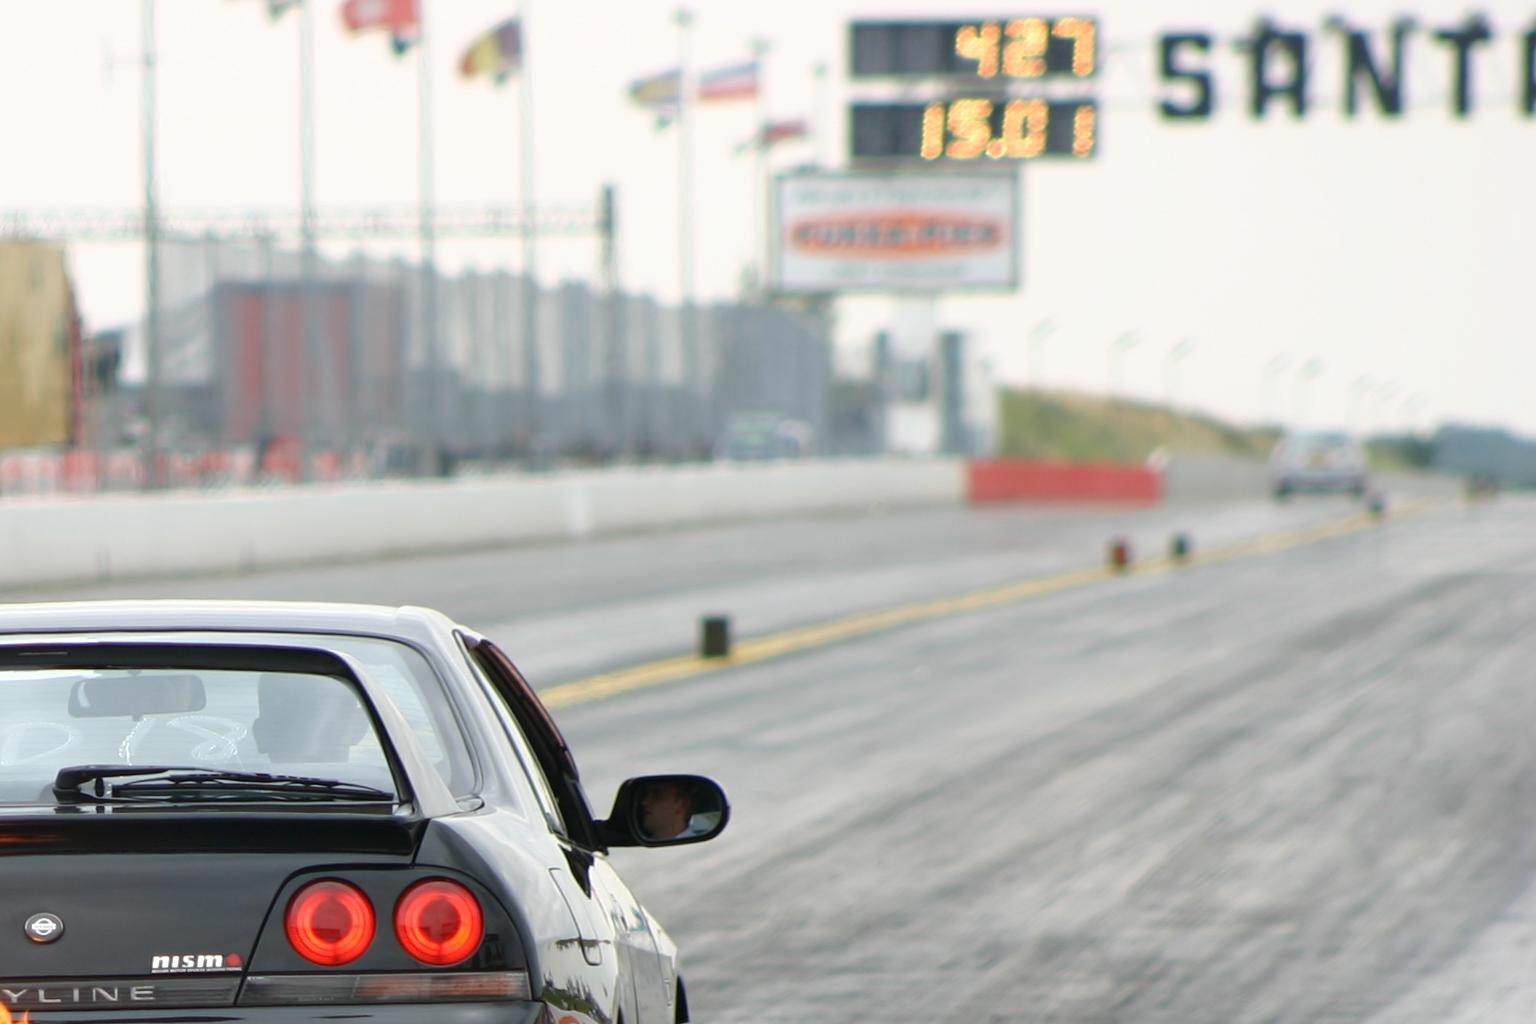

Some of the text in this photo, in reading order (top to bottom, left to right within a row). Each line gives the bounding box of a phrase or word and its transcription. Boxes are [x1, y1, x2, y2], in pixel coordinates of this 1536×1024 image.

[955, 17, 1095, 78] 427
[1157, 16, 1536, 120] SANT
[920, 98, 1095, 160] 15.01
